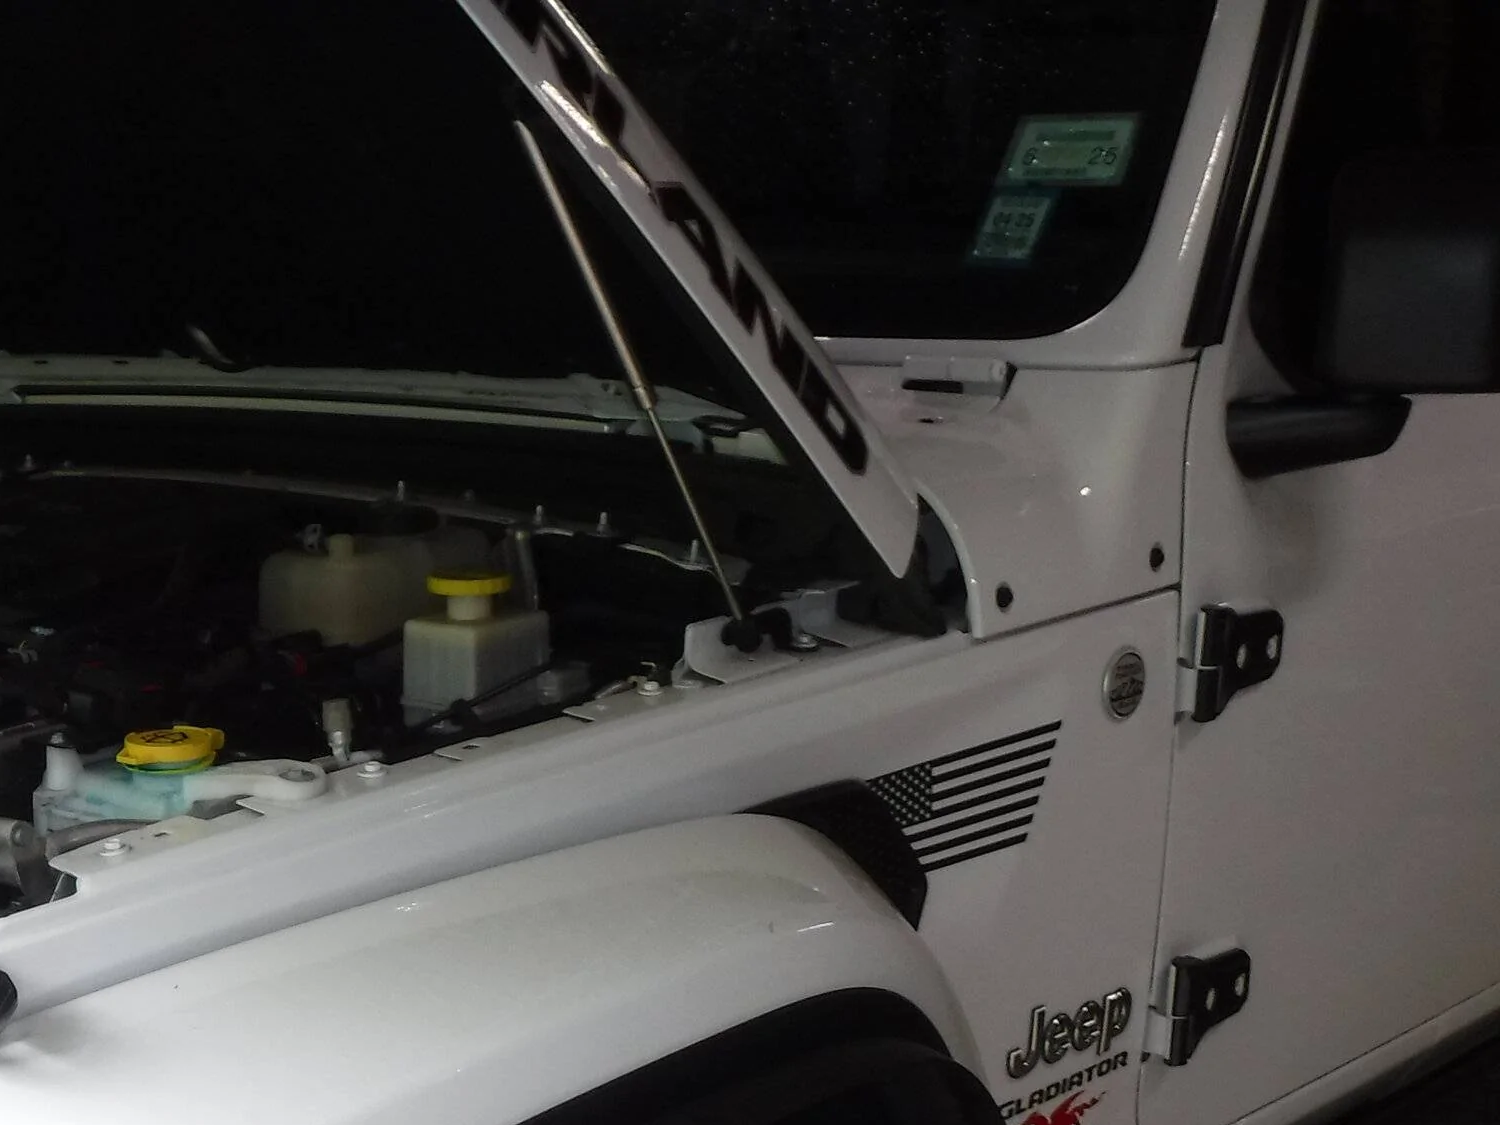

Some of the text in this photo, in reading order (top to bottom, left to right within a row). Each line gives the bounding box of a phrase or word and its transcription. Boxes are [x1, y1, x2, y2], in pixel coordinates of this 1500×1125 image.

[495, 0, 868, 476] RLAND
[1006, 987, 1132, 1078] Jeep
[1000, 1051, 1129, 1120] GLADIATOR
